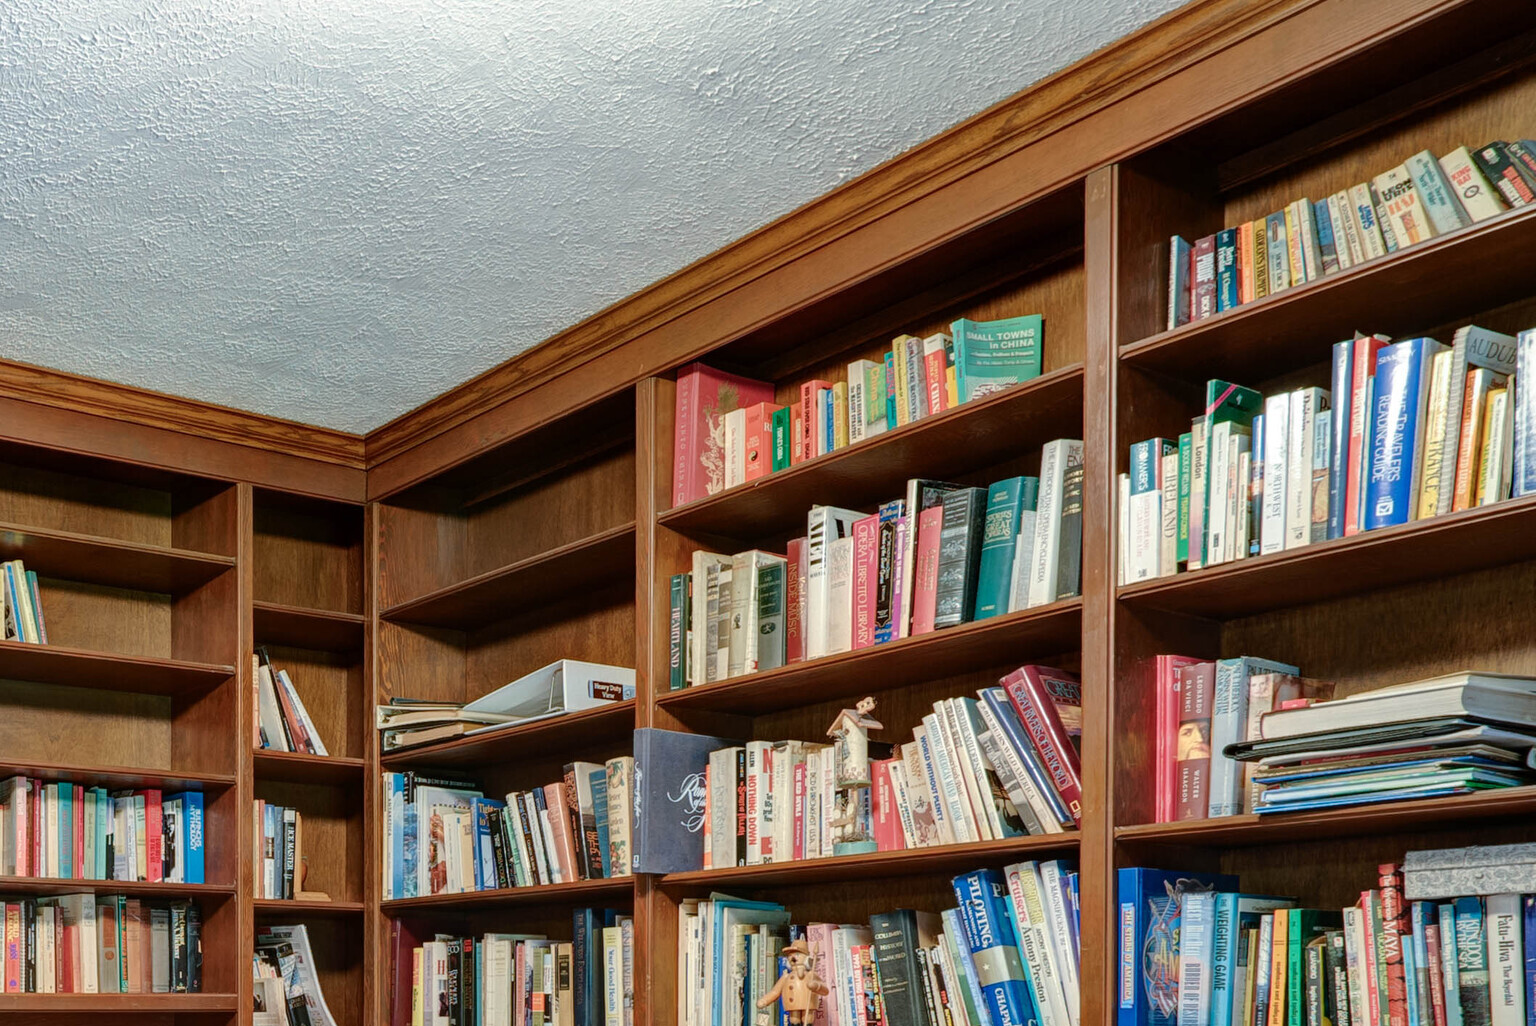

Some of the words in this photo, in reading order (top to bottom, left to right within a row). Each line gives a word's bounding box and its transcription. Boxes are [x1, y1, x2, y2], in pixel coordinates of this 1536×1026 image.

[1381, 178, 1411, 196] LEON
[966, 331, 994, 342] SMALL
[996, 329, 1035, 341] TOWNS
[1000, 338, 1035, 349] CHINA
[1375, 395, 1391, 446] READING
[1194, 446, 1204, 479] London
[1372, 447, 1386, 483] GUIDE
[1164, 475, 1176, 538] IRELAND
[1272, 463, 1281, 518] NORTHWEST
[857, 525, 868, 557] OPERA
[788, 563, 798, 600] INSIDE
[857, 559, 867, 603] LIBRETTO
[788, 602, 798, 638] MUSIC
[857, 605, 868, 644] LIBRARY
[671, 607, 680, 668] HEARTLAND
[593, 682, 610, 691] Heavy
[611, 684, 622, 694] Duty
[1185, 680, 1192, 689] DA
[920, 735, 931, 761] WORLD
[748, 775, 757, 815] NOTHING
[924, 762, 936, 795] WITHOUT
[1181, 768, 1189, 803] ISAACSON
[932, 796, 944, 821] PLENTY
[748, 817, 757, 846] DOWN
[1048, 869, 1056, 884] THE
[1383, 874, 1394, 886] The
[967, 875, 993, 948] PILOTING,
[1049, 885, 1062, 936] MAGNIFICENT
[1124, 910, 1132, 925] THE
[1383, 887, 1394, 920] Mysterious
[622, 923, 631, 954] SAND
[1009, 871, 1027, 923] Cruisers
[1022, 927, 1037, 963] Antony
[1032, 964, 1046, 1003] Preston
[1124, 927, 1132, 951] STORY
[1215, 910, 1229, 961] WEIGHTING
[1384, 922, 1398, 958] MAYA
[1466, 919, 1483, 969] KINGDOM
[1498, 915, 1514, 962] Fatu-Hiva
[607, 949, 616, 963] Your
[1036, 928, 1046, 950] ANTONY
[1042, 952, 1052, 977] PRESTON
[1124, 953, 1132, 963] OF
[607, 964, 616, 986] Good
[623, 957, 631, 992] RIVERS
[1123, 965, 1132, 1002] AMERICA
[1185, 963, 1201, 991] BURDEN
[1214, 965, 1227, 991] GAME
[1502, 966, 1513, 978] Thor
[608, 987, 617, 1012] Health
[1184, 992, 1200, 1002] OF
[1501, 979, 1514, 1006] Heyerdahl
